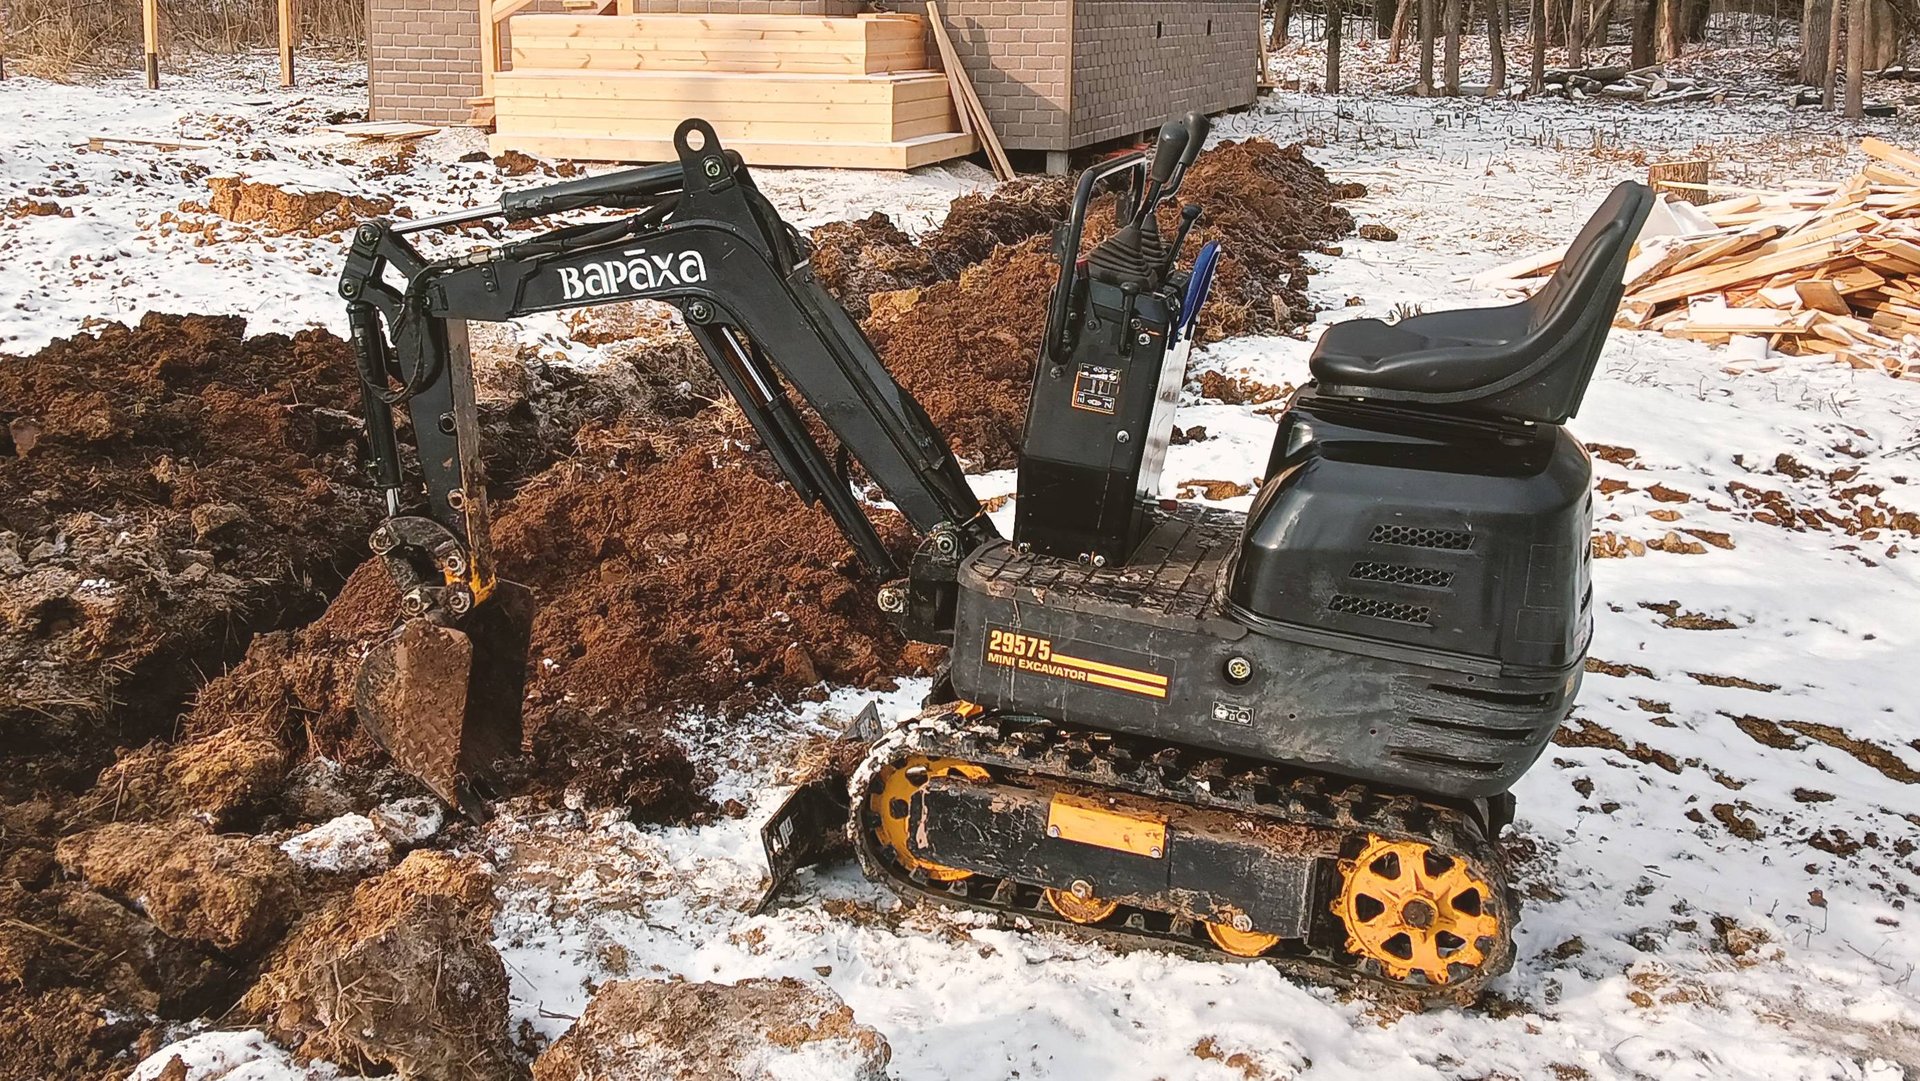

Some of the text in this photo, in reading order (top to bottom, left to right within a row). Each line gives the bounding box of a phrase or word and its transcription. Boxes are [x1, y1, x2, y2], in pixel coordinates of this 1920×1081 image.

[989, 630, 1051, 661] 29575
[988, 653, 1087, 681] MINI EXCAVATOR
